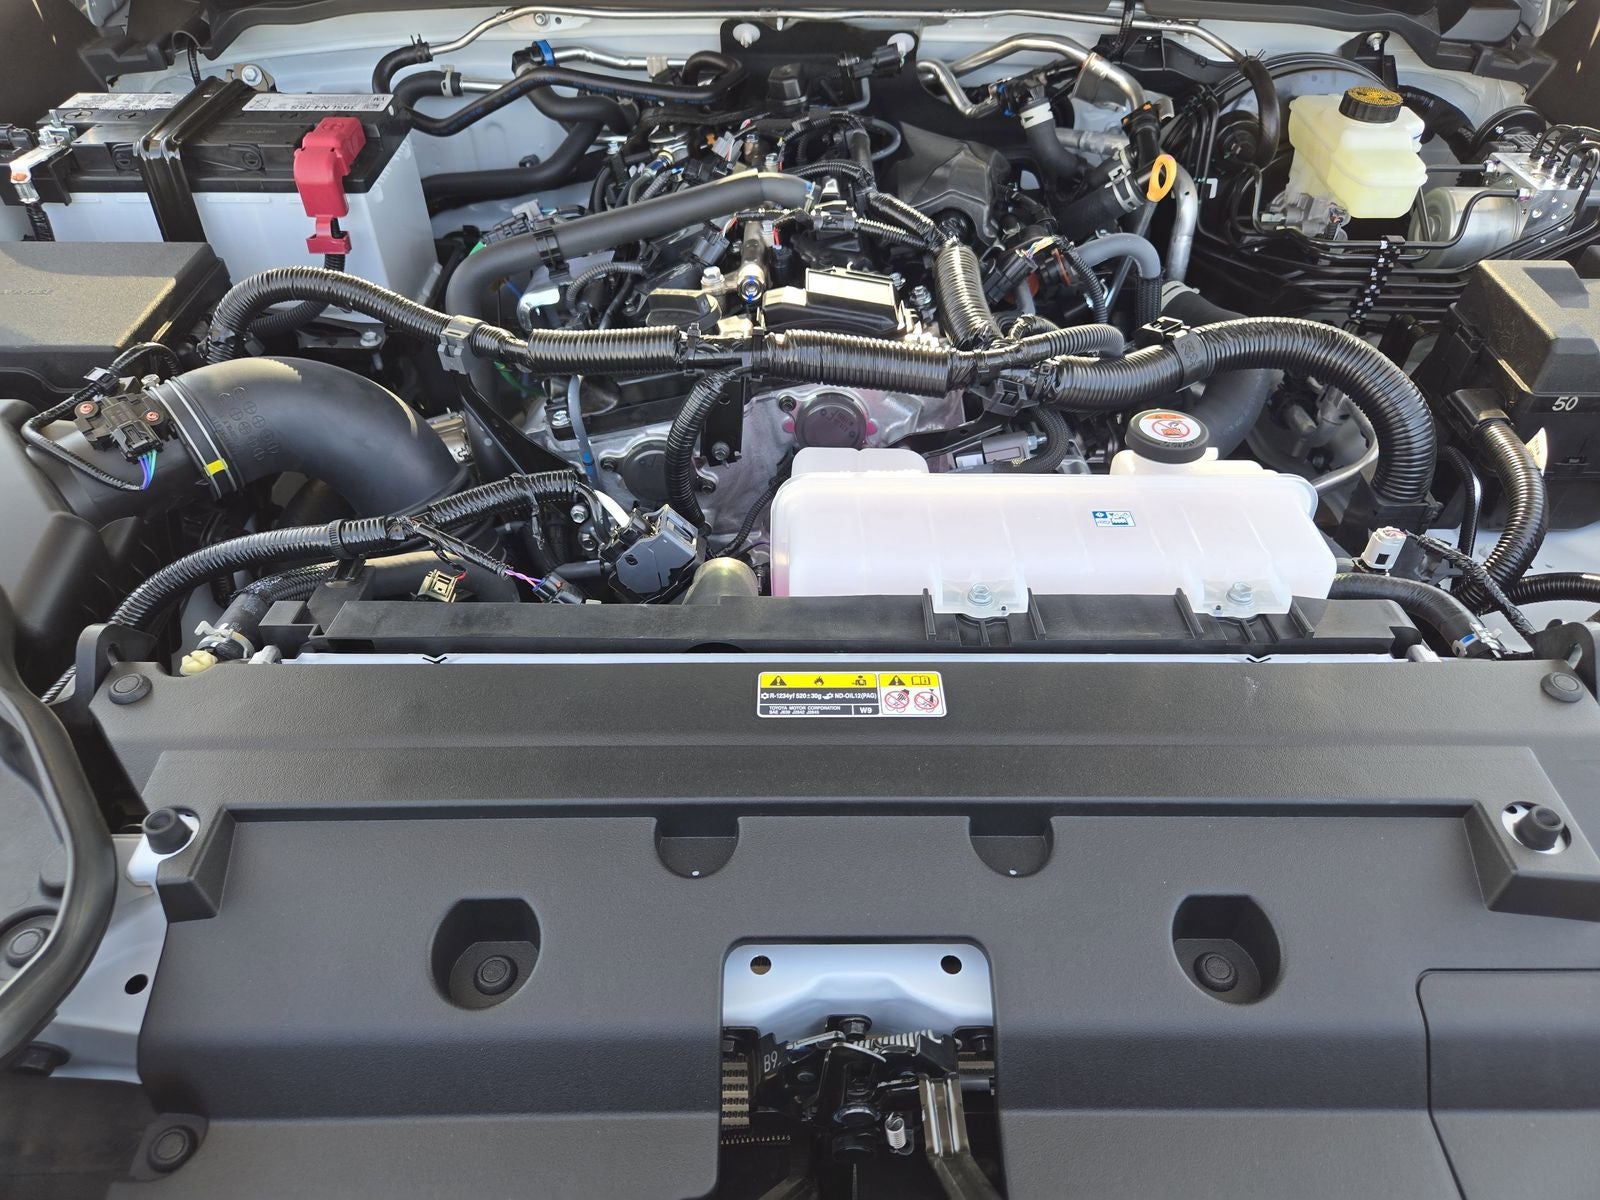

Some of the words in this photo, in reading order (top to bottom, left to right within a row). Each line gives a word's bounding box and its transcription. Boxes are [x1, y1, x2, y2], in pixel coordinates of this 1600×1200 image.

[1552, 396, 1578, 411] 50
[769, 692, 796, 700] R-1234yf
[859, 706, 873, 714] W9
